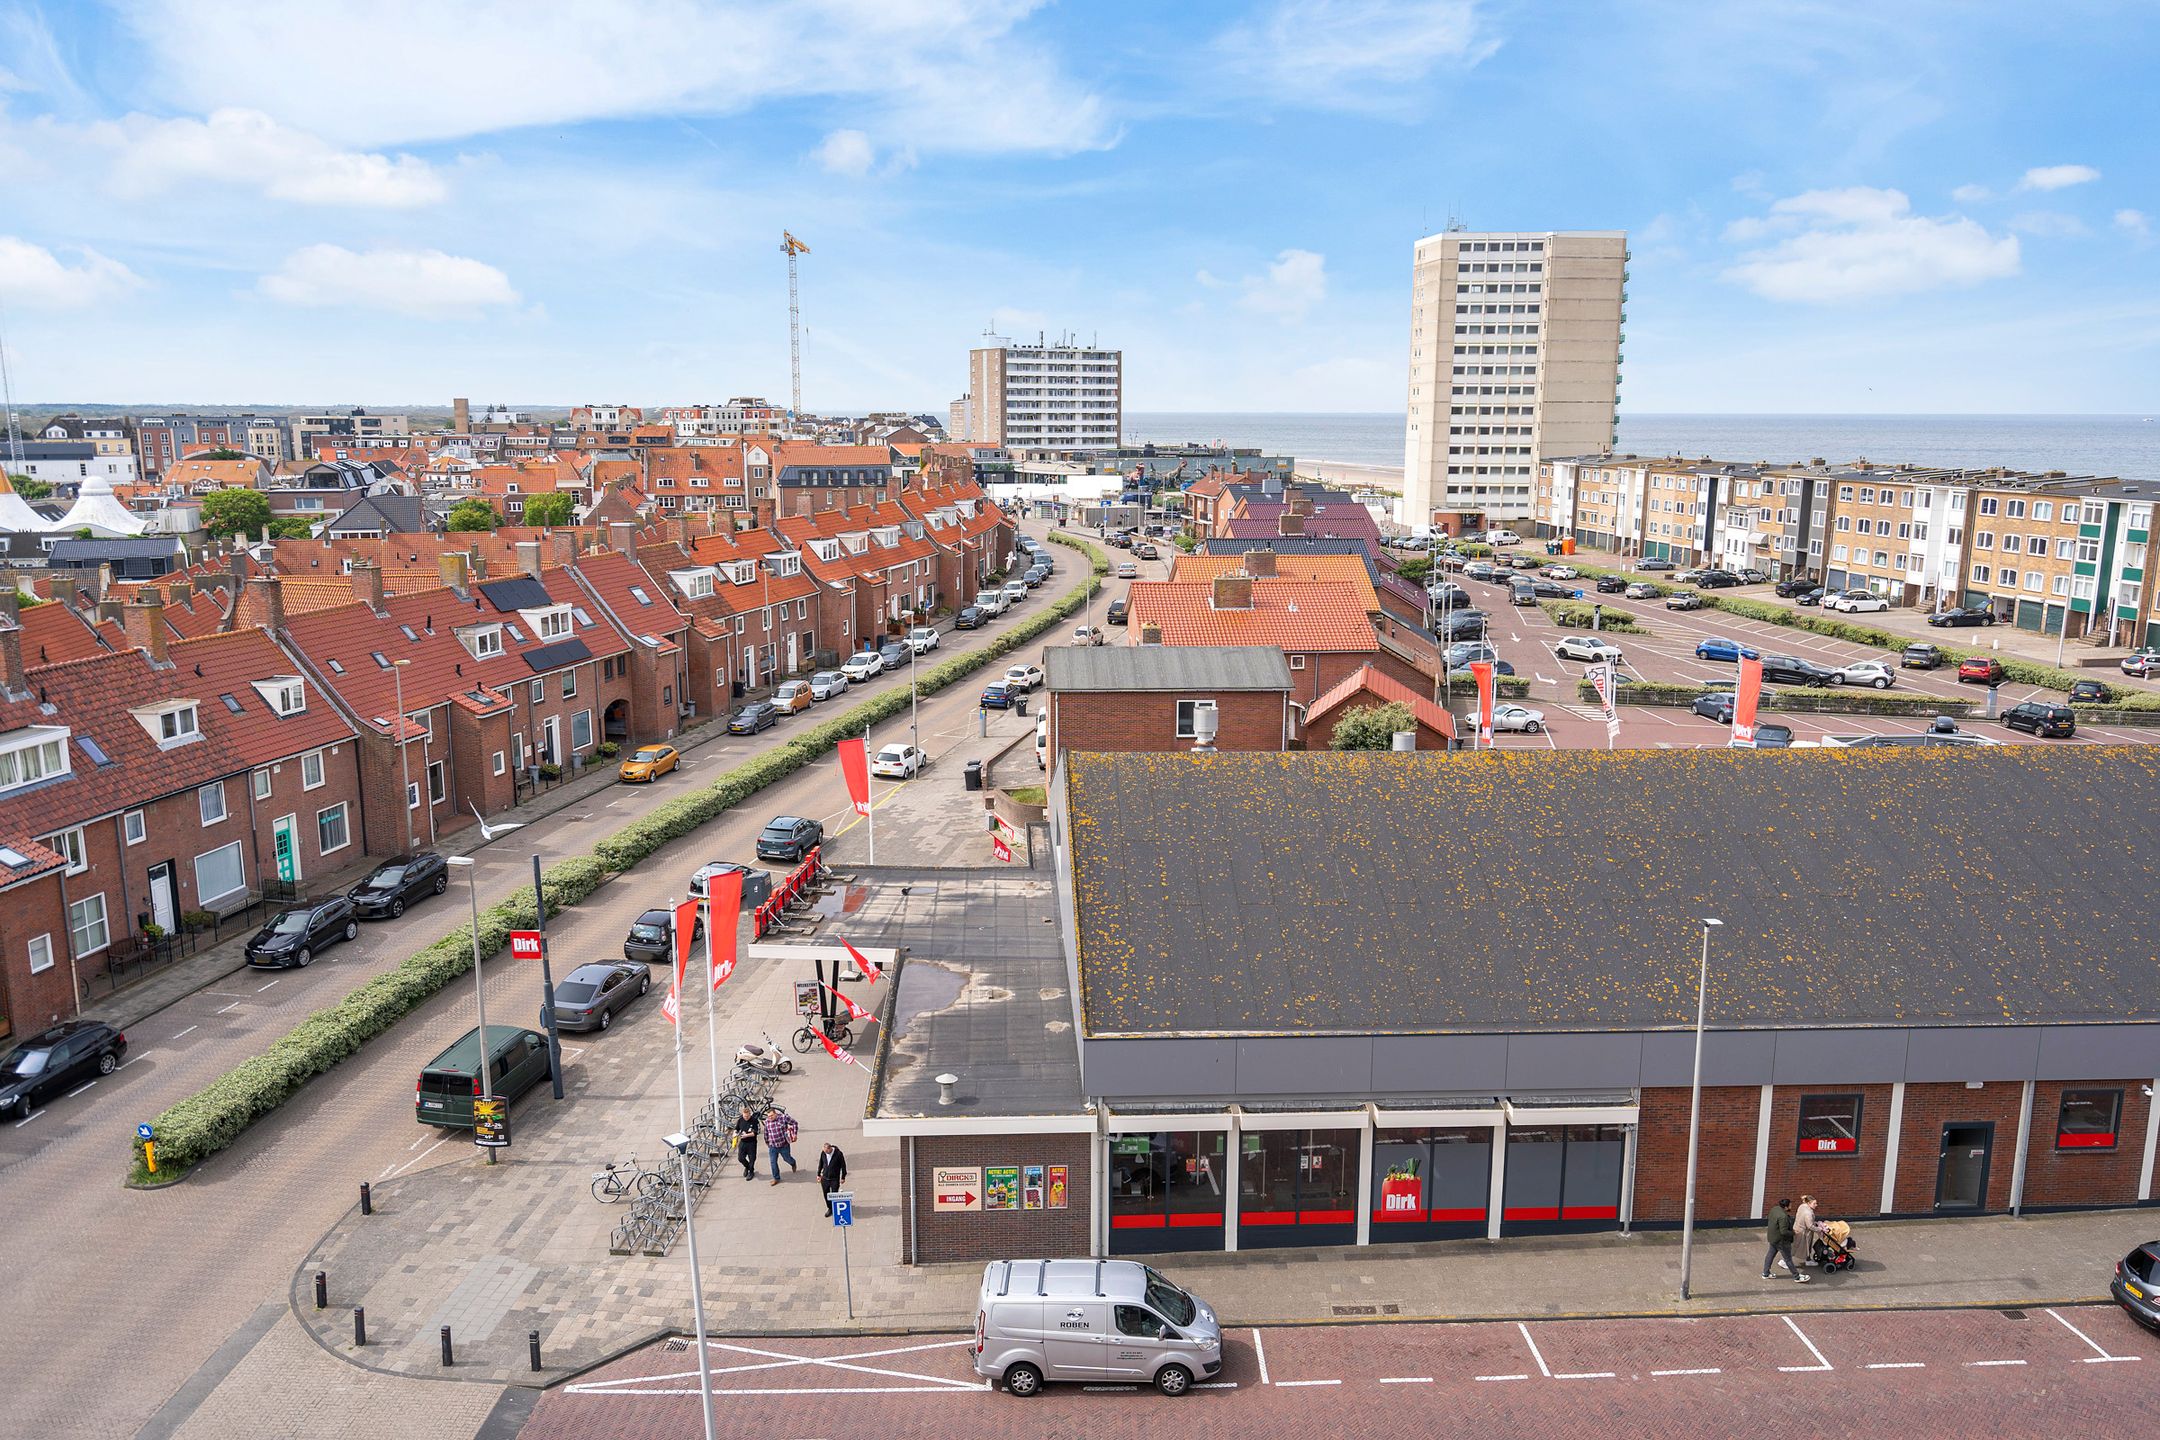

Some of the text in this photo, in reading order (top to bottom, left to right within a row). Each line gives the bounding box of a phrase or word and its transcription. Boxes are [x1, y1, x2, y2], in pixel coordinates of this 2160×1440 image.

[513, 938, 540, 952] Dirk
[1817, 1139, 1837, 1151] Dirk
[836, 1202, 847, 1215] P
[1386, 1194, 1416, 1211] Dirk
[1060, 1321, 1090, 1329] ROBEN
